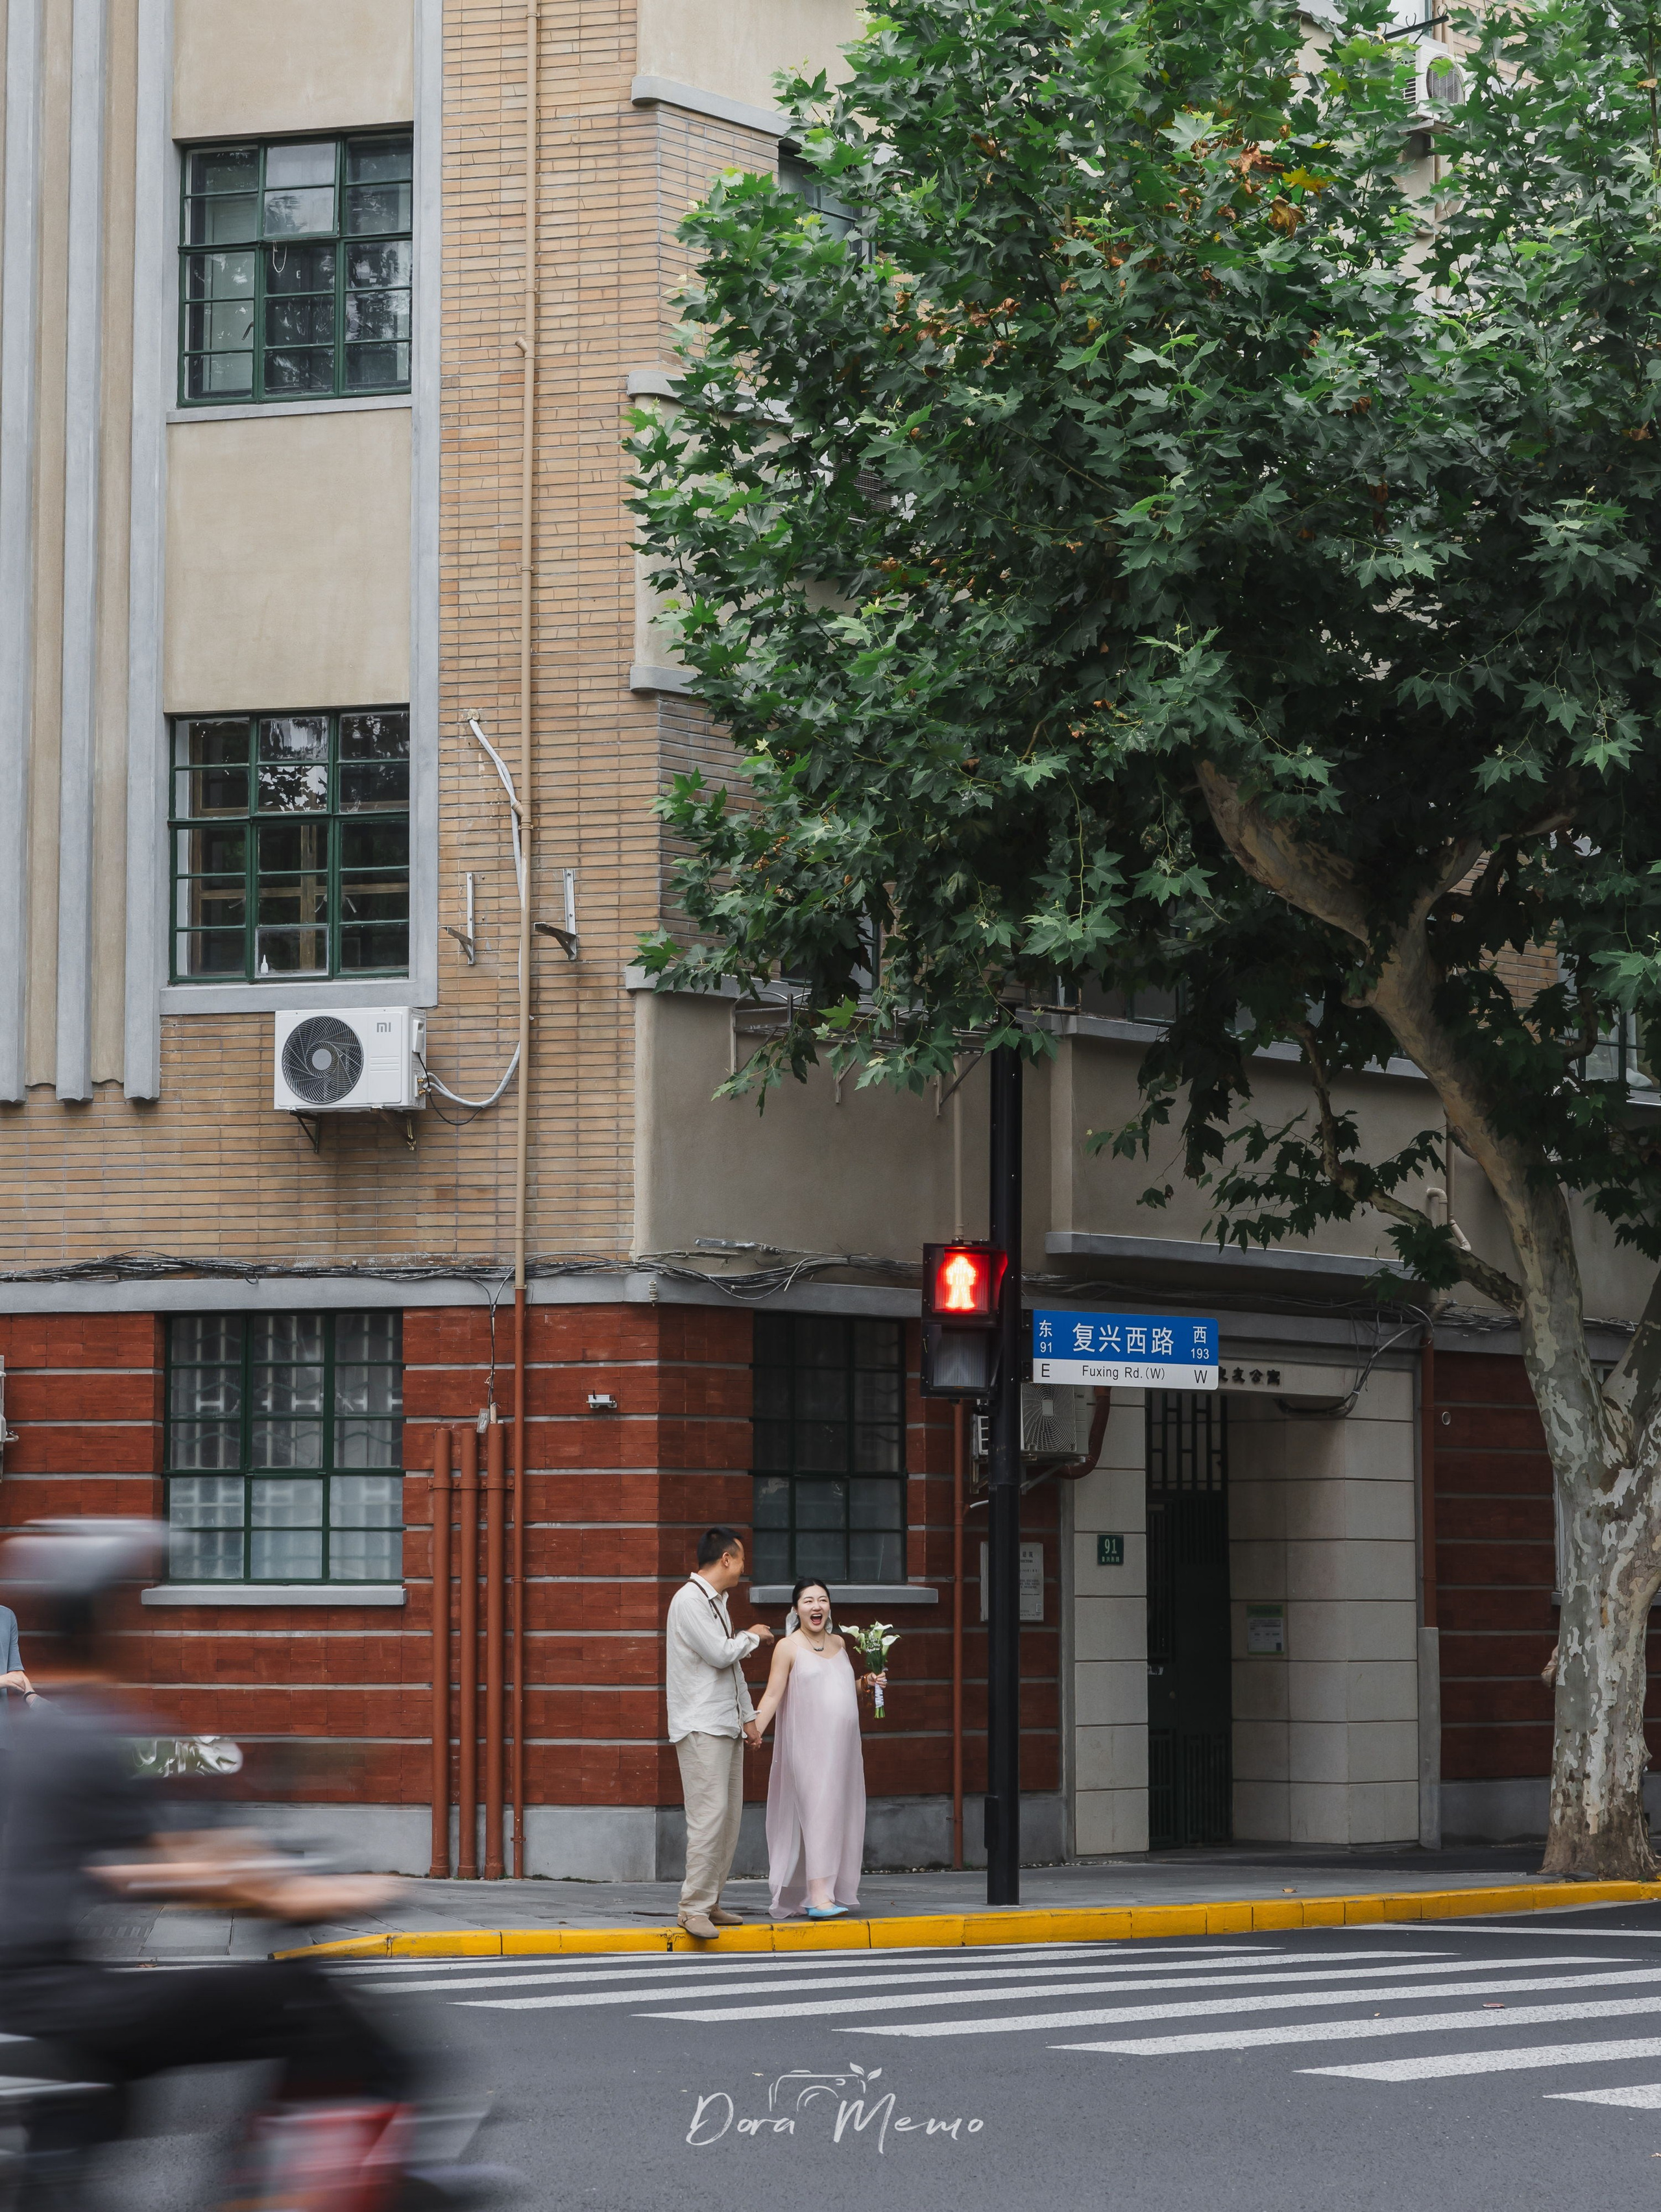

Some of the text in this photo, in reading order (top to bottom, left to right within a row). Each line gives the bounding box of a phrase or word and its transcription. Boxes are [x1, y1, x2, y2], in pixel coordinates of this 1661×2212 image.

[1039, 1319, 1052, 1337] 东
[1193, 1327, 1207, 1344] 西
[1073, 1323, 1174, 1355] 复兴西路
[1040, 1341, 1052, 1353] 91
[1191, 1348, 1209, 1359] 193
[1041, 1364, 1050, 1377] E
[1082, 1365, 1119, 1380] Fuxing
[1194, 1369, 1207, 1384] W
[1105, 1538, 1117, 1554] 91
